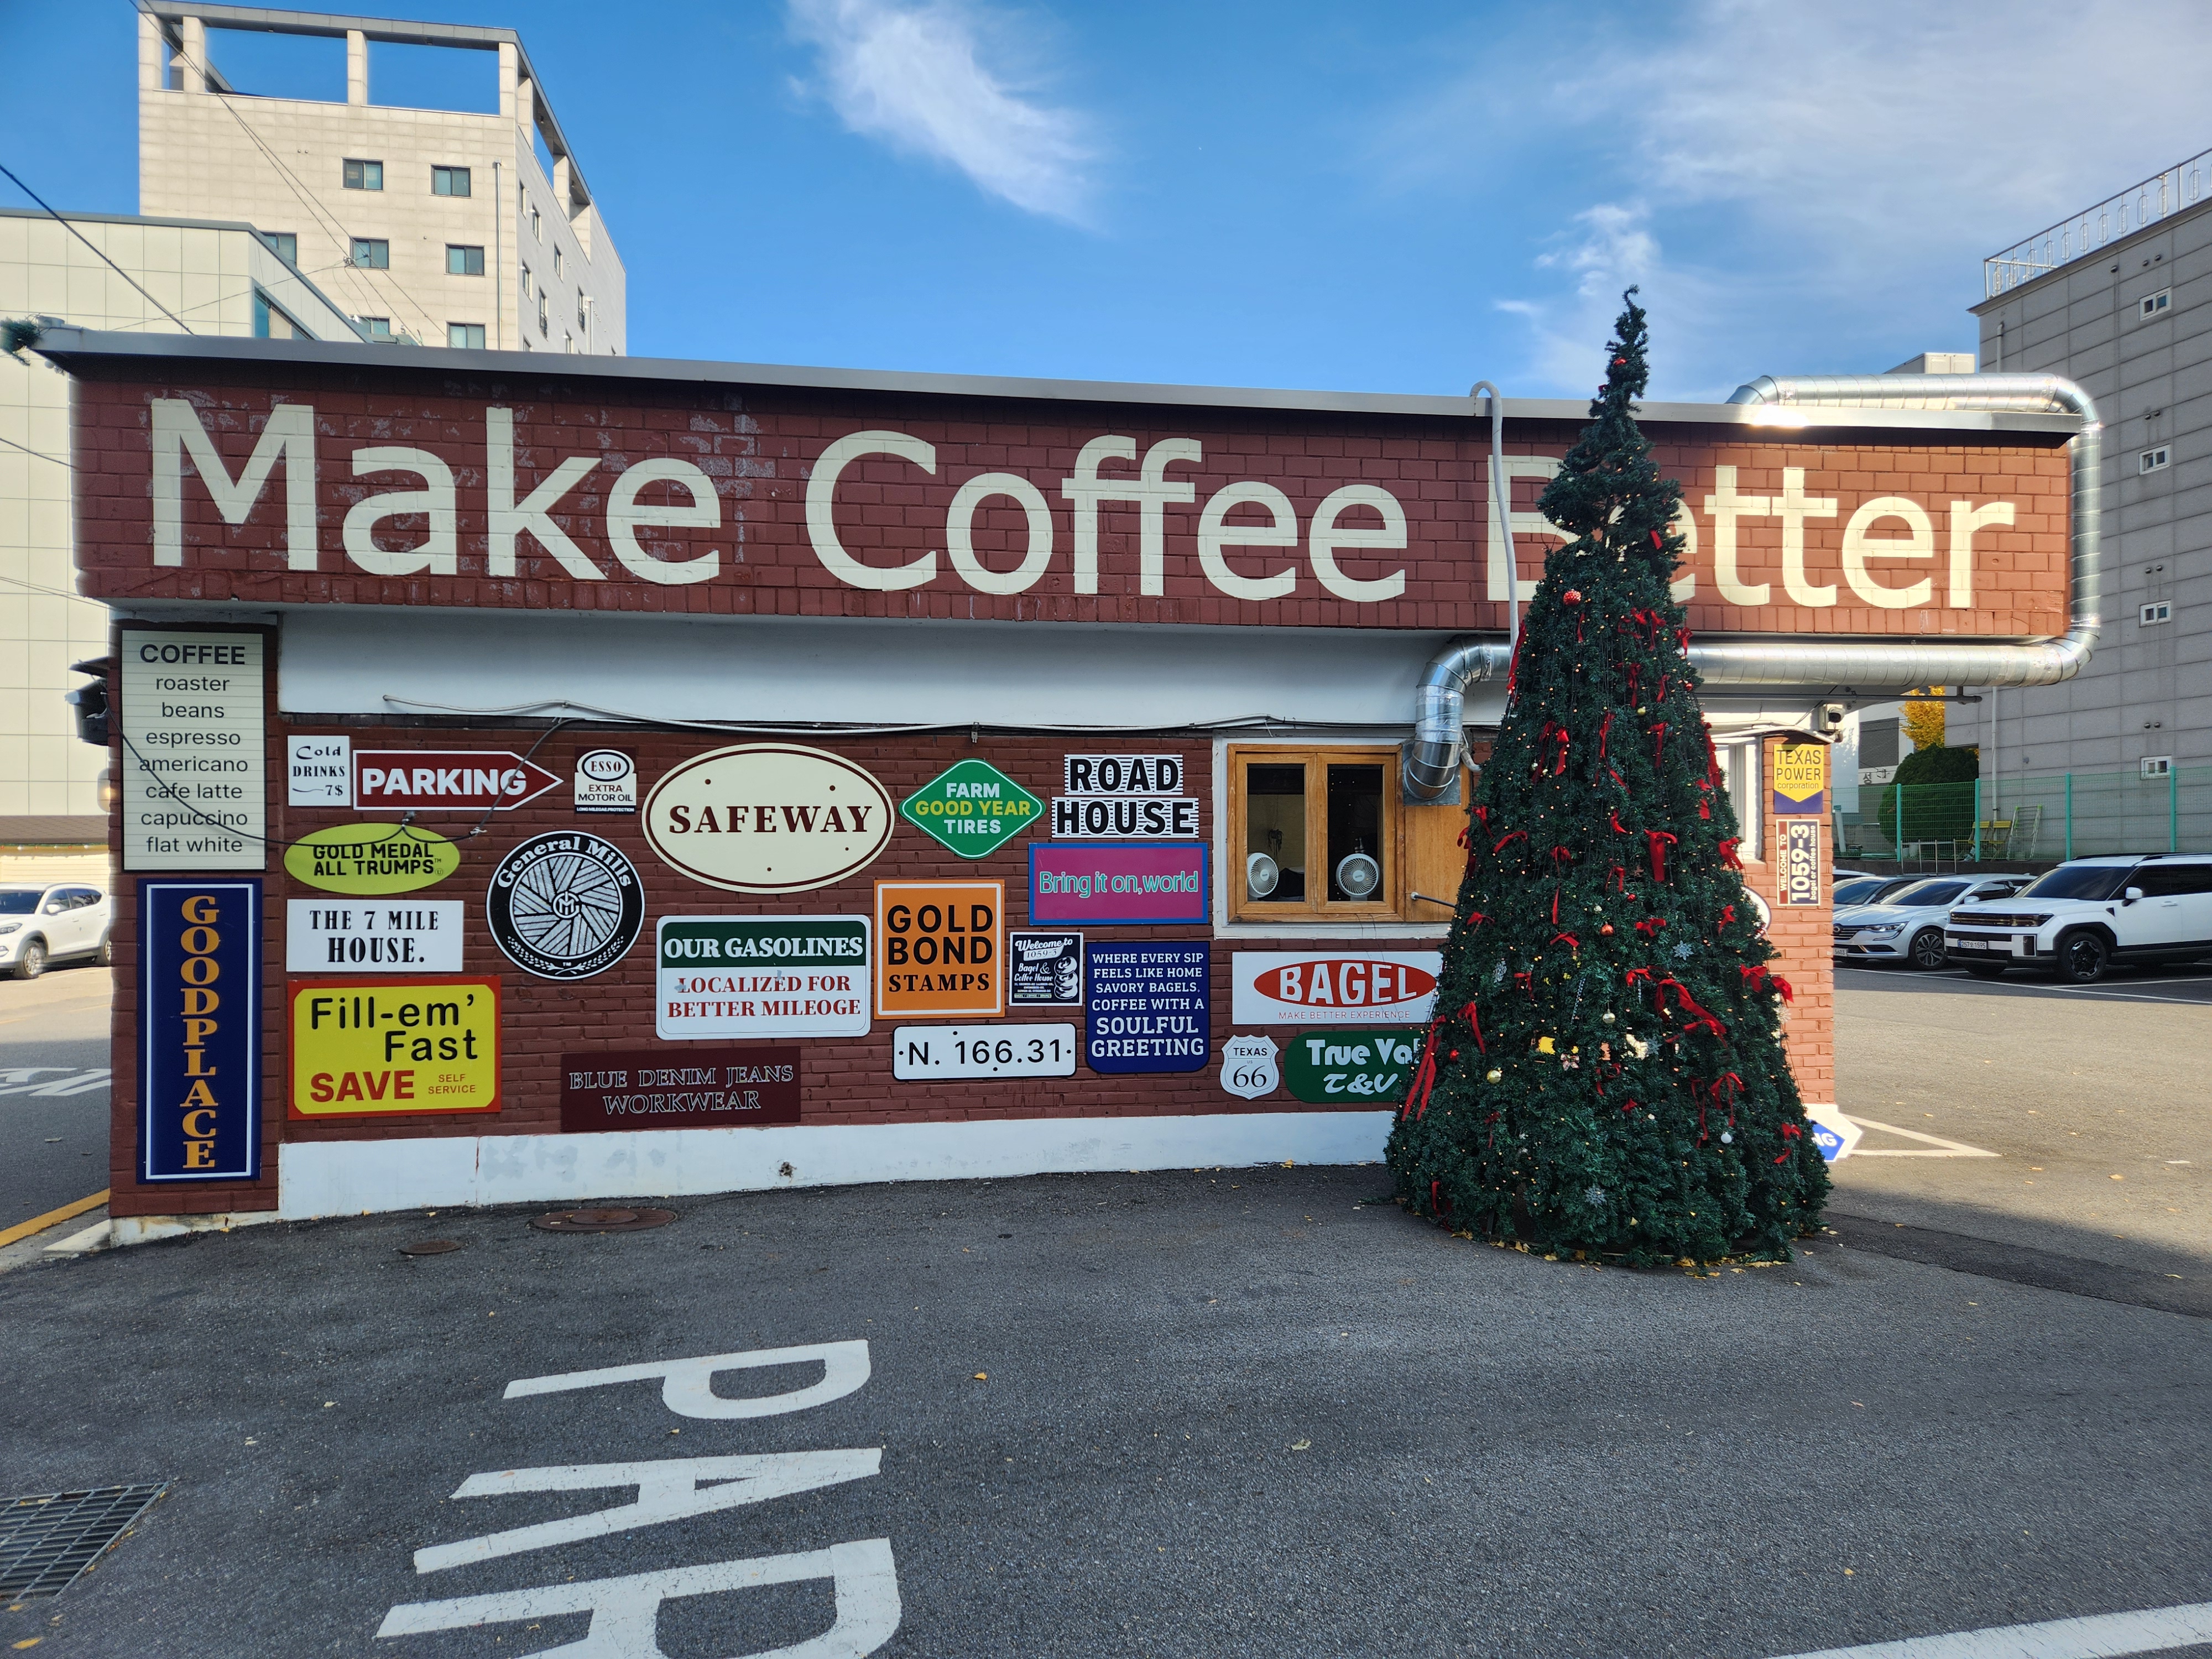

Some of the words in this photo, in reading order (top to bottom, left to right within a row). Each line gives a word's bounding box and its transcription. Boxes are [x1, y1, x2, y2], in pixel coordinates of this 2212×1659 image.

[152, 398, 721, 584] Make
[805, 430, 1407, 602] Coffee
[140, 644, 245, 665] COFFEE
[156, 676, 229, 691] roaster
[162, 702, 225, 718] beans
[146, 732, 241, 748] espresso
[295, 745, 341, 759] Cold
[1776, 750, 1821, 765] TEXAS
[139, 757, 248, 771] americano
[293, 766, 346, 778] DRINKS
[591, 761, 621, 772] ESSO
[362, 769, 526, 796] PARKING
[1070, 758, 1178, 791] ROAD
[1776, 768, 1820, 780] POWER
[146, 783, 190, 799] cafe
[198, 784, 242, 799] latte
[325, 785, 343, 796] 7$
[946, 782, 1000, 798] FARM
[1777, 782, 1818, 791] corporation
[915, 800, 973, 816] GOOD
[978, 800, 1030, 816] YEAR
[140, 811, 248, 829] capuccino
[669, 805, 873, 834] SAFEWAY
[1057, 801, 1194, 834] HOUSE
[944, 819, 1001, 834] TIRES
[147, 837, 179, 852] flat
[186, 837, 242, 852] white
[1779, 834, 1787, 846] TO
[313, 845, 363, 859] GOLD
[371, 843, 434, 858] MEDAL
[314, 860, 347, 876] ALL
[353, 859, 434, 875] TRUMPS
[498, 836, 581, 888] General
[586, 839, 632, 886] Mills
[1791, 825, 1810, 901] 1059-3
[1040, 871, 1091, 899] Bring
[1095, 871, 1108, 893] it
[310, 910, 352, 930] THE
[364, 910, 375, 930] 7
[388, 910, 439, 930] MILE
[887, 904, 993, 933] GOLD
[327, 937, 425, 963] HOUSE.
[664, 937, 721, 958] OUR
[724, 937, 863, 958] GASOLINES
[888, 937, 993, 966] BOND
[1015, 940, 1063, 951] Welcome
[1063, 937, 1073, 946] to
[1027, 949, 1057, 958] 1059-3
[1092, 953, 1137, 963] WHERE
[1141, 953, 1180, 963] EVERY
[1183, 952, 1203, 963] SIP
[1018, 963, 1039, 974] Bagel
[1040, 962, 1051, 974] &
[1094, 968, 1131, 979] FEELS
[1135, 968, 1164, 978] LIKE
[1167, 967, 1202, 978] HOME
[677, 977, 802, 994] LOCALIZED
[807, 975, 851, 992] FOR
[889, 972, 989, 992] STAMPS
[1095, 982, 1145, 993] SAVORY
[1280, 962, 1417, 1005] BAGEL
[667, 1001, 755, 1018] BETTER
[760, 999, 860, 1016] MILEOGE
[1092, 999, 1147, 1011] COFFEE
[1150, 999, 1190, 1010] WITH
[1194, 998, 1204, 1009] A
[180, 895, 220, 1168] GOODPLACE
[1096, 1016, 1199, 1035] SOULFUL
[384, 1029, 478, 1062] Fast
[908, 1041, 940, 1066] N.
[955, 1039, 1060, 1064] 166.31
[1092, 1038, 1204, 1058] GREETING
[1233, 1047, 1267, 1056] TEXAS
[1306, 1039, 1370, 1066] True
[438, 1073, 466, 1083] SELF
[569, 1071, 627, 1090] BLUE
[638, 1067, 716, 1087] DENIM
[725, 1064, 794, 1087] JEANS
[1233, 1065, 1267, 1087] 66
[310, 1070, 415, 1102] SAVE
[428, 1084, 476, 1095] SERVICE
[602, 1091, 761, 1115] WORKWEAR
